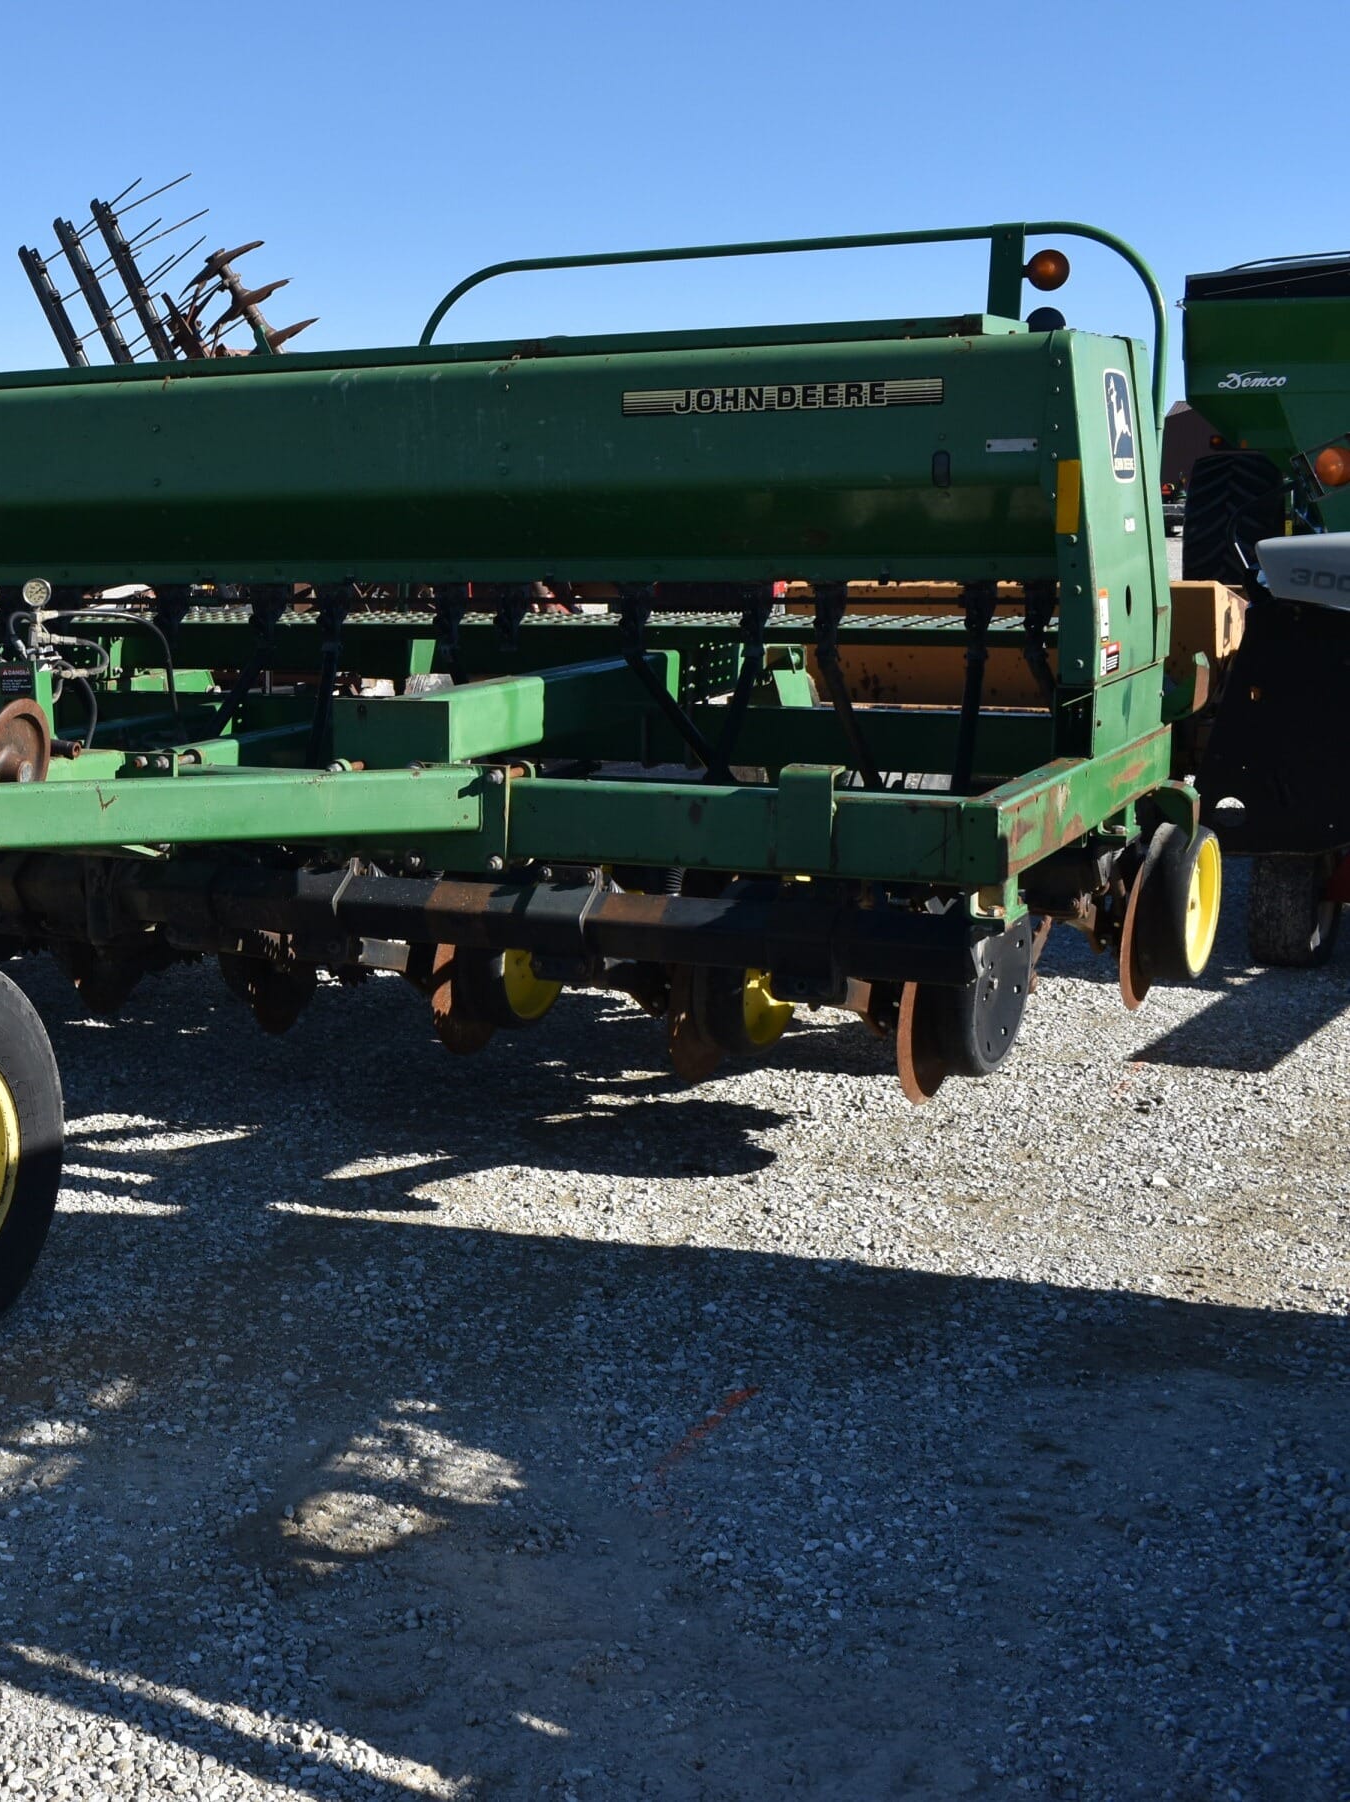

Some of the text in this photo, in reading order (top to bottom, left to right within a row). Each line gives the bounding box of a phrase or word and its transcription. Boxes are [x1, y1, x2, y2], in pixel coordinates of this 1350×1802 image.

[1218, 371, 1287, 390] Demco
[674, 382, 887, 414] JOHN DEERE
